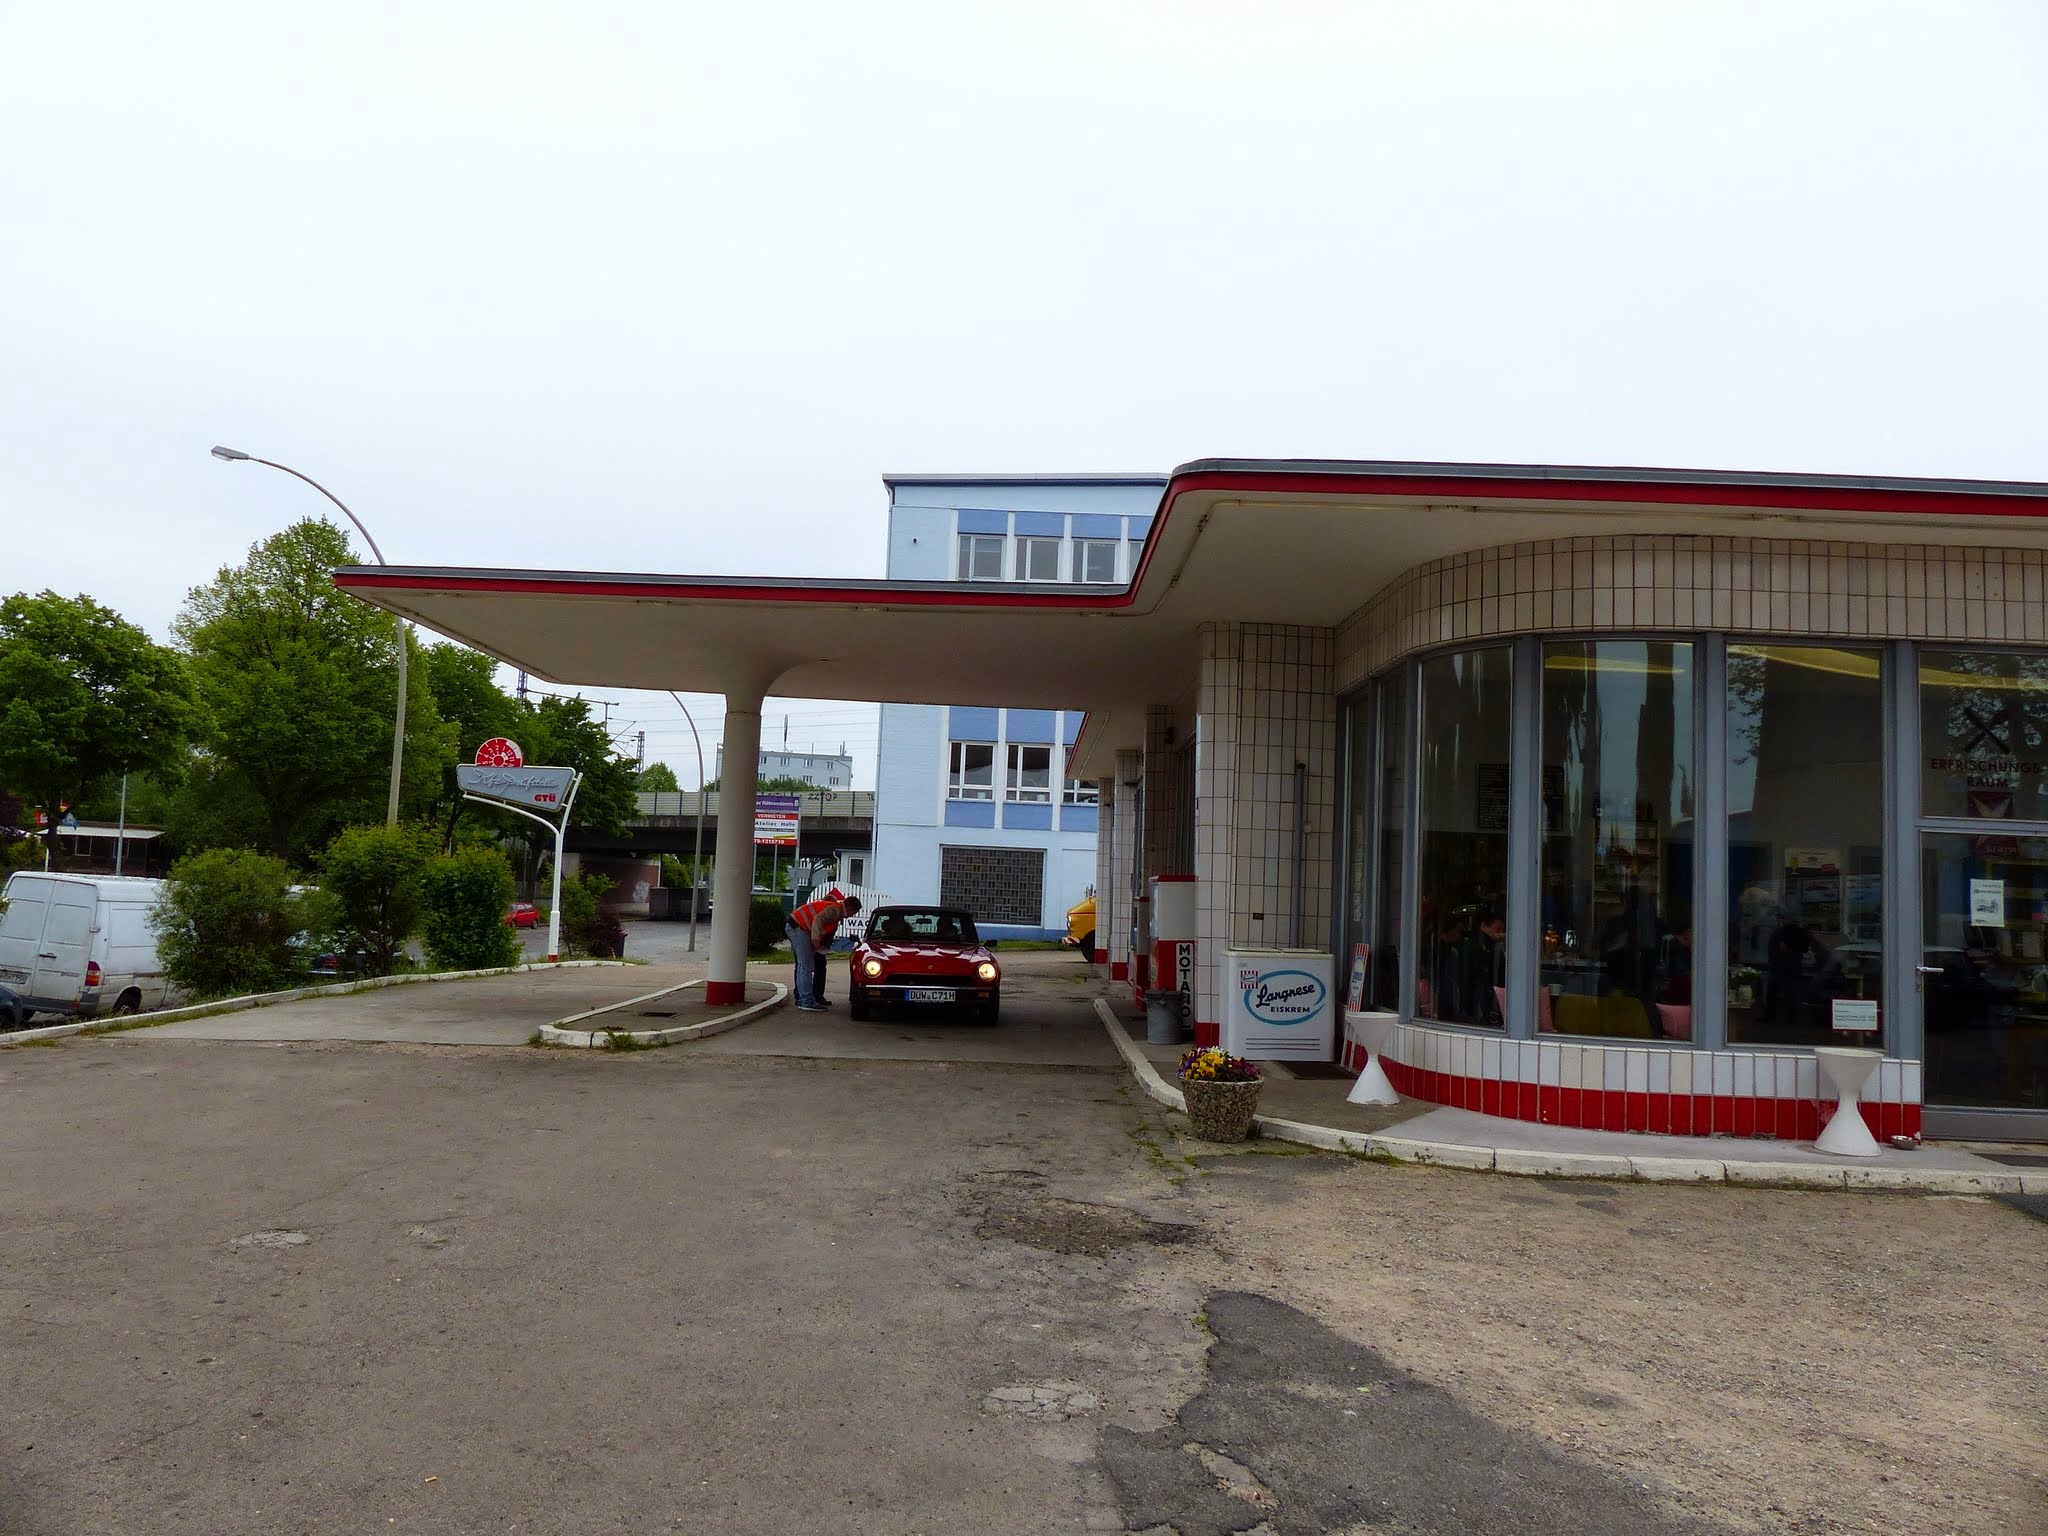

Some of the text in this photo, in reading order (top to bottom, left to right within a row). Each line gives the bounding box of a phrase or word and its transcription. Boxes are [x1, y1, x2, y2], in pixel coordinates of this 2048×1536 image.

[1967, 776, 2009, 788] RAUM
[794, 799, 799, 807] 8
[1256, 983, 1316, 1009] Langnese
